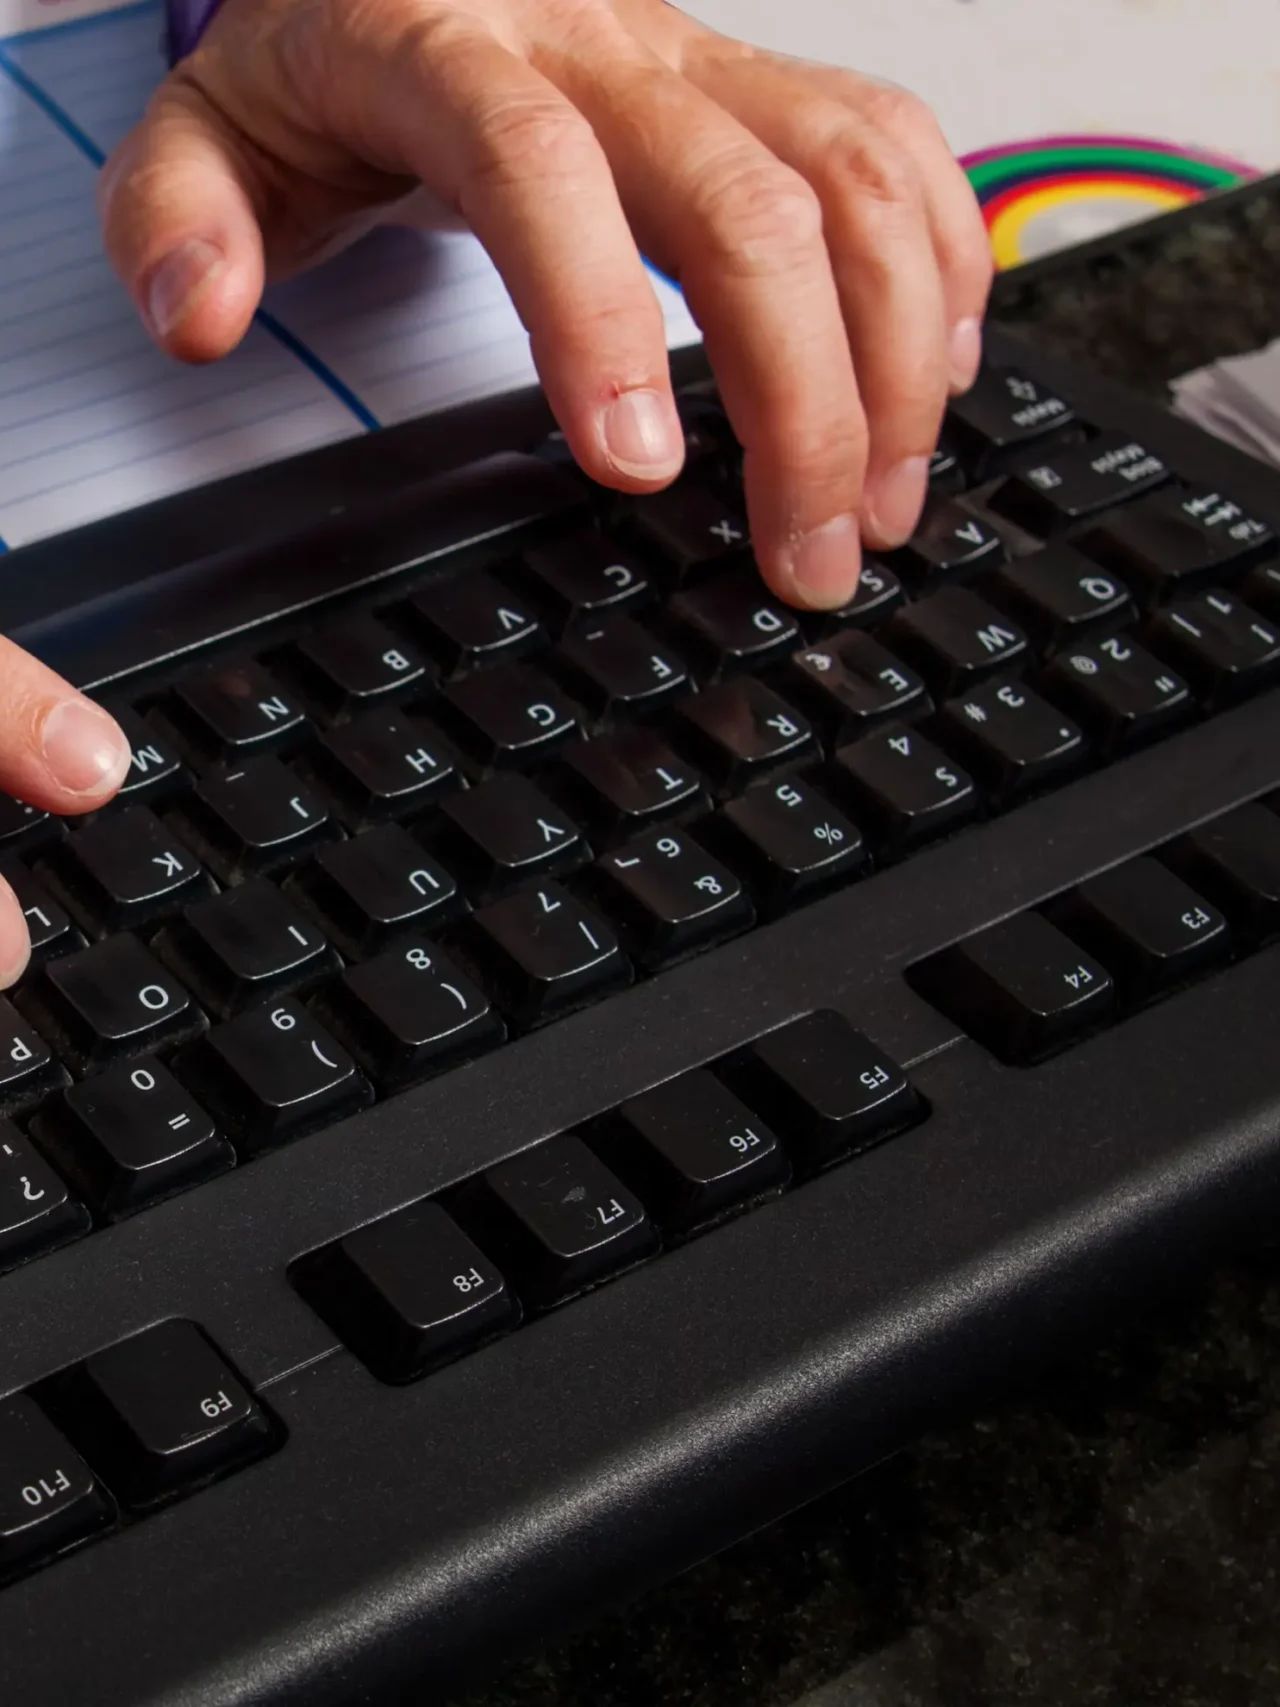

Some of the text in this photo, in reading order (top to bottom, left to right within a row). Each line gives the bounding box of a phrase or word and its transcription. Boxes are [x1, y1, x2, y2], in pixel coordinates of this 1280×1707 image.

[710, 521, 741, 543] X
[956, 522, 986, 545] A
[604, 565, 631, 586] C
[860, 569, 884, 589] S
[1079, 577, 1115, 600] Q
[1208, 597, 1231, 613] 1
[498, 608, 524, 629] V
[754, 610, 782, 631] D
[978, 625, 1016, 652] W
[383, 650, 409, 670] B
[1101, 639, 1130, 660] 2
[652, 656, 671, 677] F
[880, 669, 908, 690] E
[997, 687, 1024, 707] 3
[259, 697, 289, 720] N
[528, 704, 555, 725] G
[767, 715, 798, 736] R
[889, 737, 909, 755] 4
[132, 745, 163, 772] M
[406, 749, 436, 773] H
[657, 768, 683, 790] T
[776, 785, 802, 806] 5
[291, 797, 308, 818] J
[537, 819, 564, 841] Y
[814, 823, 843, 844] %
[657, 838, 680, 857] 6
[153, 852, 183, 876] K
[409, 870, 439, 895] U
[694, 876, 722, 894] &
[538, 892, 560, 912] 7
[25, 907, 51, 926] L
[1182, 908, 1210, 929] F3
[406, 949, 431, 969] 8
[1064, 966, 1092, 988] F4
[139, 985, 168, 1009] O
[271, 1008, 295, 1030] 9
[11, 1037, 32, 1061] P
[860, 1066, 889, 1089] F5
[729, 1128, 761, 1154] F6
[20, 1177, 44, 1200] ?
[597, 1199, 625, 1224] F7
[453, 1268, 484, 1292] F8
[201, 1391, 232, 1417] F9
[22, 1470, 70, 1505] F10
